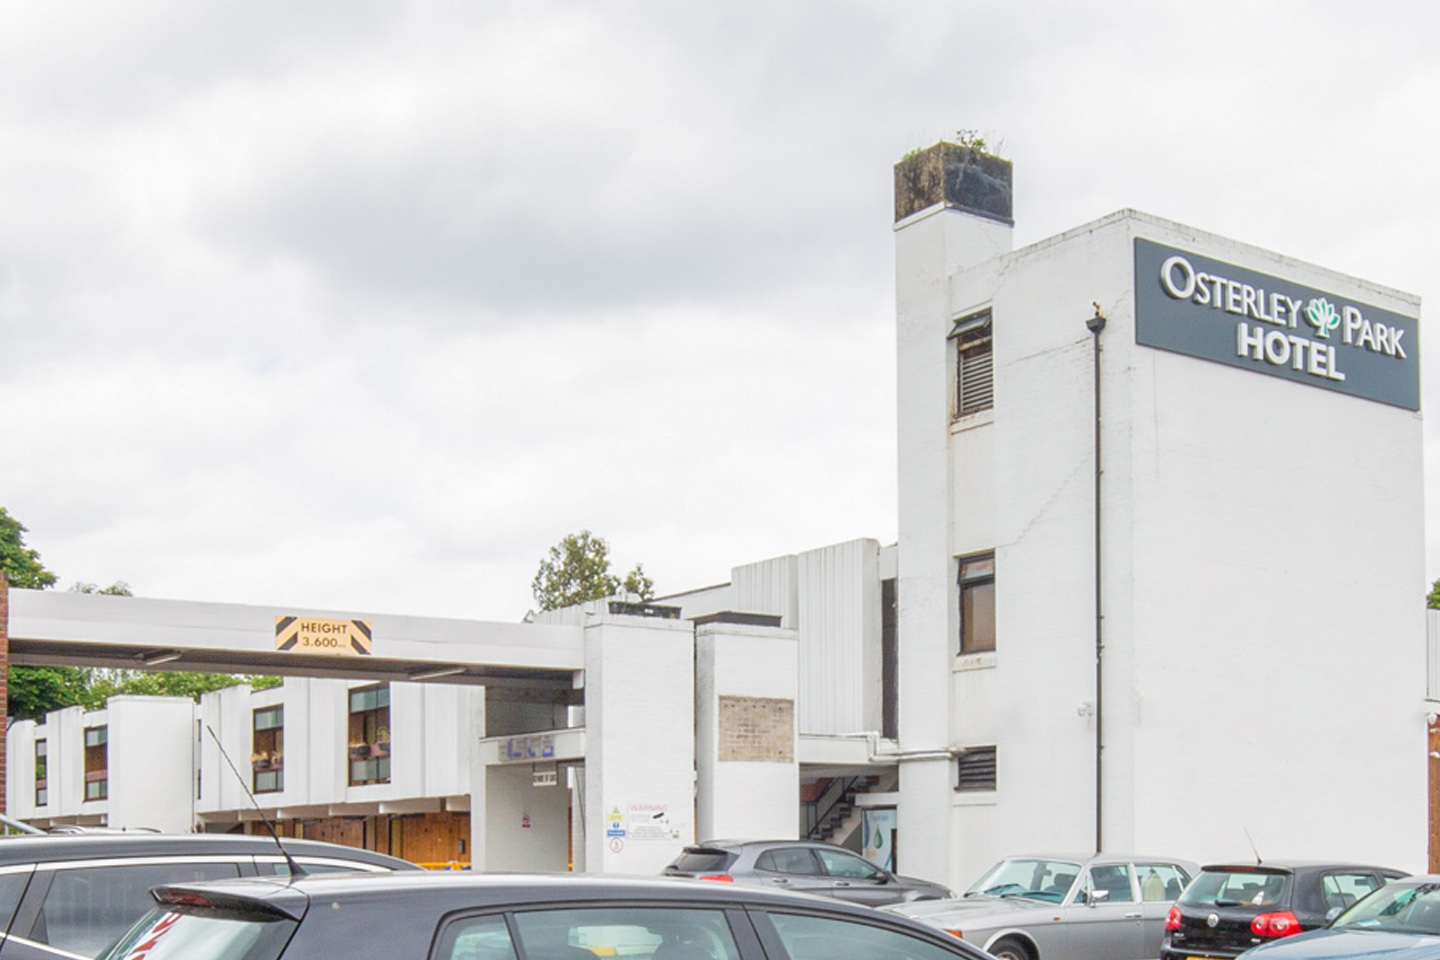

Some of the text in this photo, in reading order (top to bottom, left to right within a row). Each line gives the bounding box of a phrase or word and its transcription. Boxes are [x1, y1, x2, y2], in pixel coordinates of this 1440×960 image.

[1161, 256, 1407, 359] OSTERLEY PARK
[1237, 322, 1346, 381] HOTEL
[300, 622, 348, 634] HEIGHT
